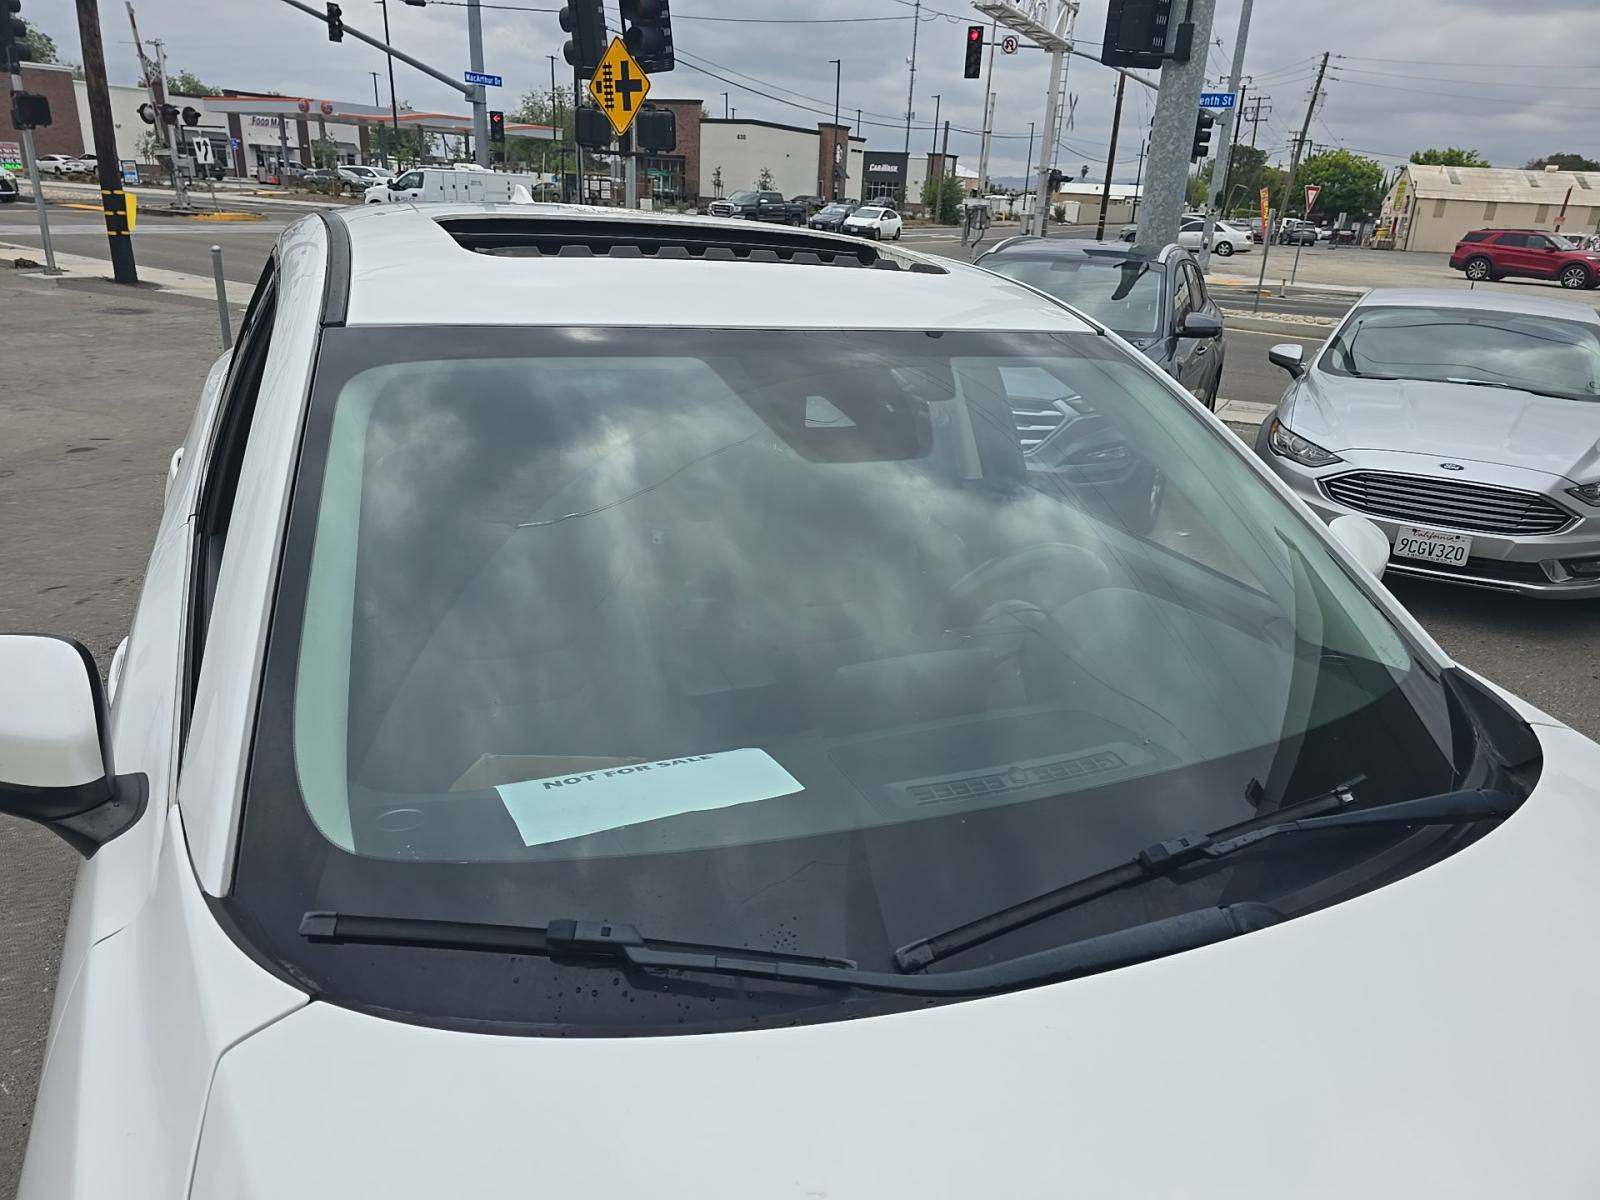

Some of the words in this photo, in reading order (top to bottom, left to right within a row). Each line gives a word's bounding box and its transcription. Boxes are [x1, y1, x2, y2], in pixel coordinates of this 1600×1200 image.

[1222, 95, 1232, 106] St
[1412, 530, 1456, 543] California
[1397, 537, 1466, 562] 9CGV320
[542, 773, 597, 790] NOT
[603, 765, 651, 778] FOR
[656, 754, 713, 768] SALE
